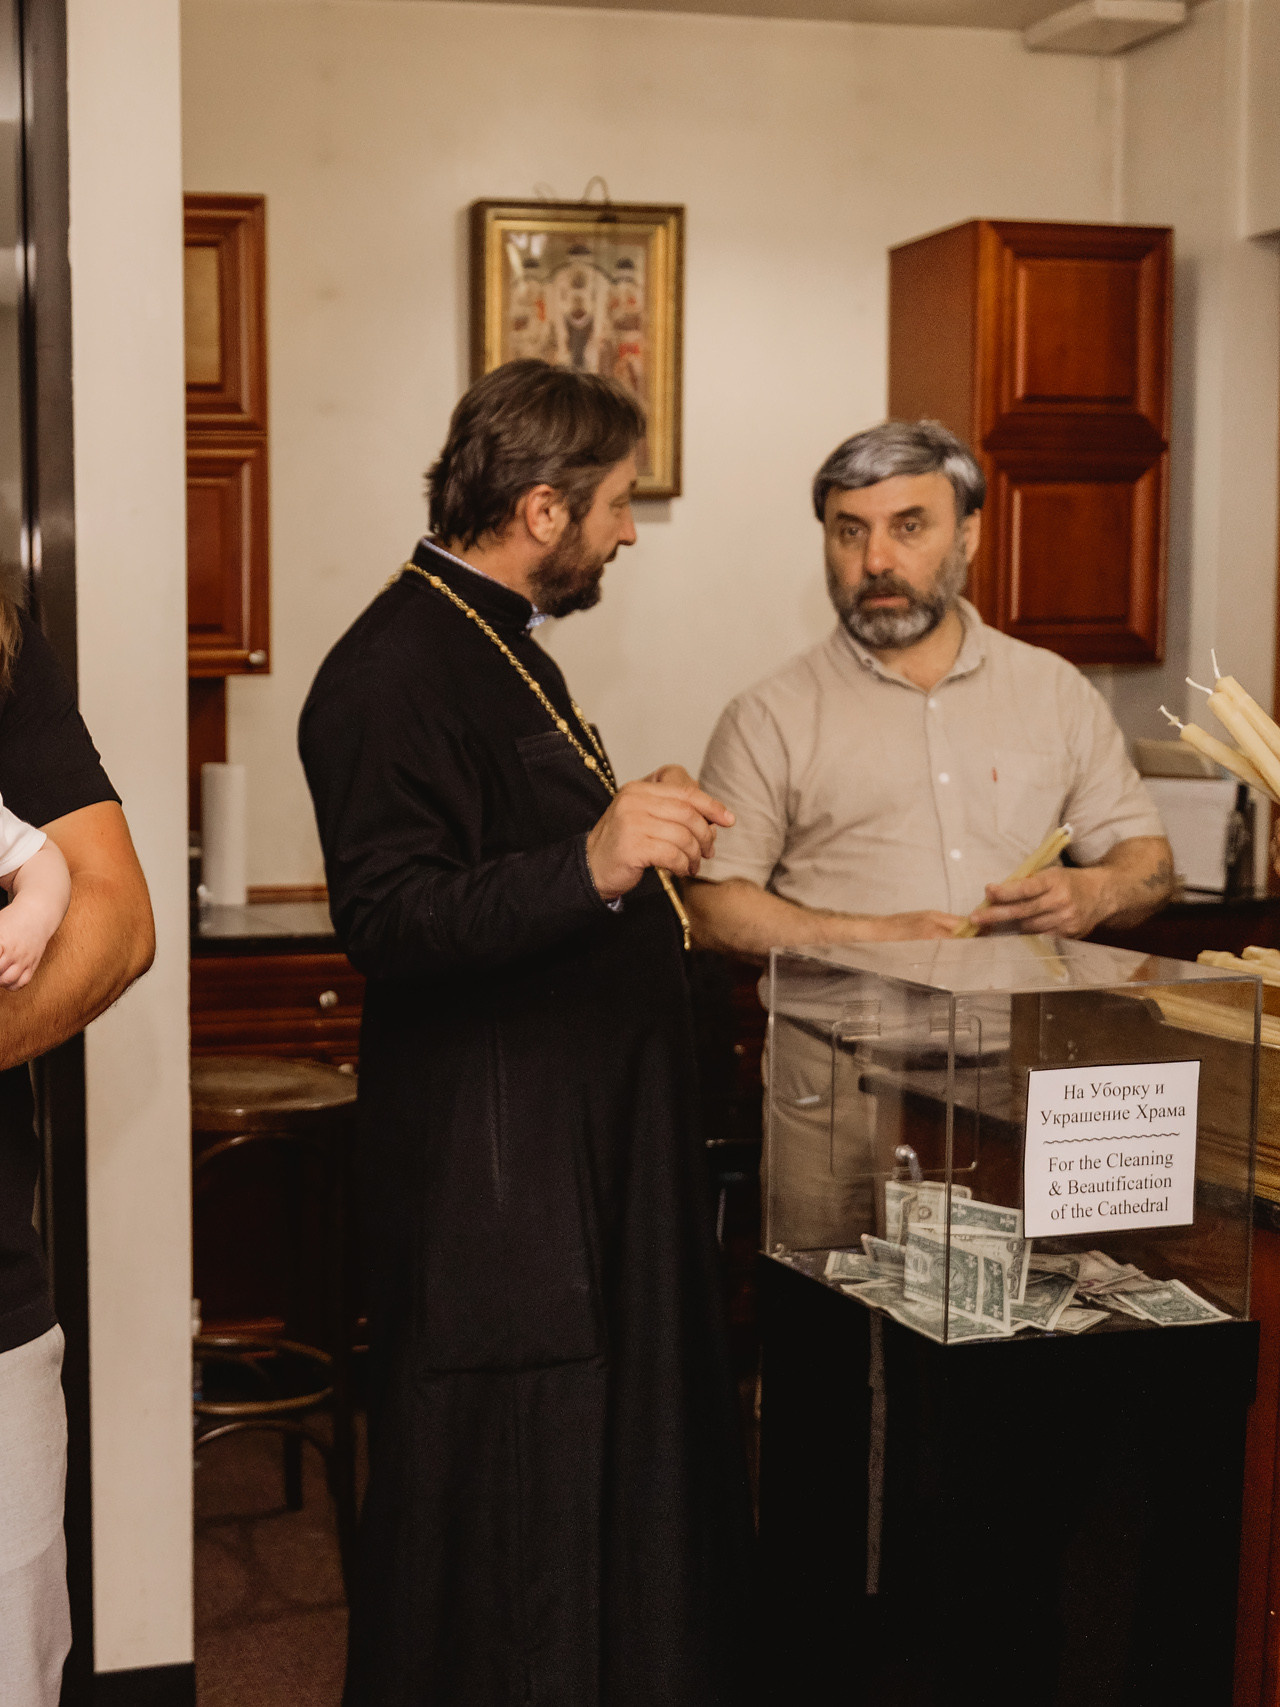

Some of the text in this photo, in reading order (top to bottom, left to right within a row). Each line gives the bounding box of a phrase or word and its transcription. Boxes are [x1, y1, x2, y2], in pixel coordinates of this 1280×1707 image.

[1064, 1082, 1165, 1100] На Уборку и
[1040, 1104, 1186, 1128] Украшение Храма
[1049, 1150, 1174, 1172] For the Cleaning
[1048, 1174, 1172, 1196] & Beautification
[1050, 1197, 1169, 1220] of the Cathedral
